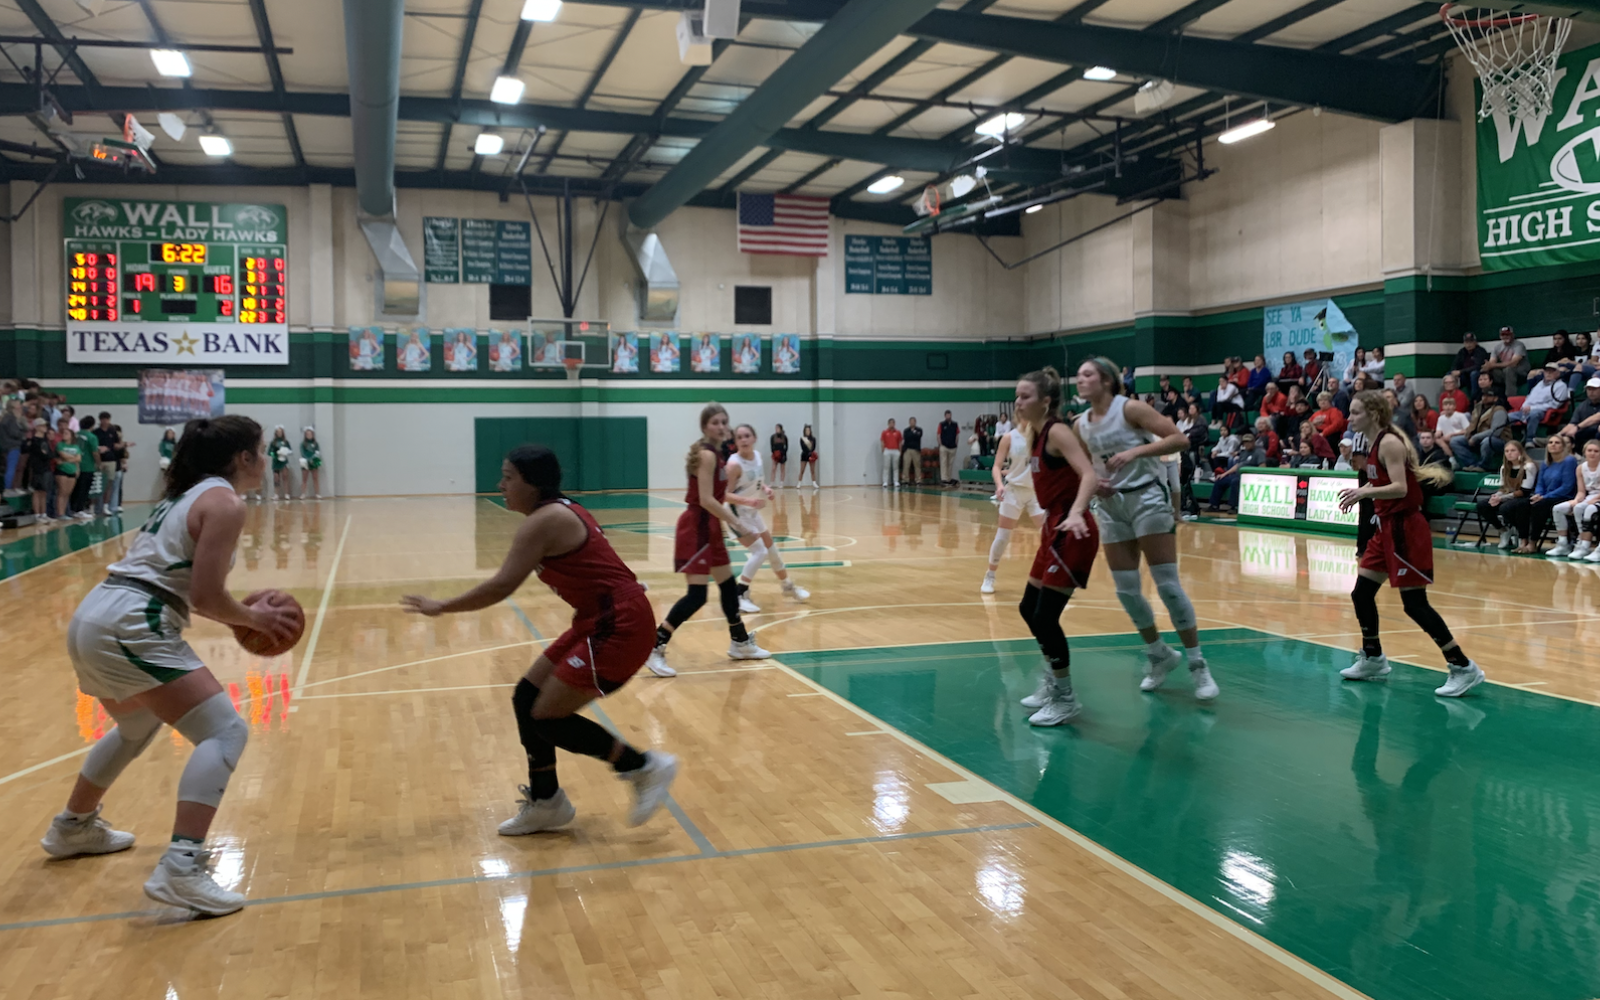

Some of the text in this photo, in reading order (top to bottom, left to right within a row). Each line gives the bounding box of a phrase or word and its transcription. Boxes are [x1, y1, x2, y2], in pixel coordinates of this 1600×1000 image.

[121, 202, 234, 229] WALL
[75, 225, 143, 238] HAWKS
[160, 226, 209, 240] LADY
[212, 229, 278, 243] HAWKS
[1484, 206, 1573, 248] HIGH
[86, 252, 98, 266] 0
[162, 243, 206, 264] 6:22
[202, 265, 231, 275] GUEST
[256, 257, 266, 270] 0
[274, 258, 284, 271] 0
[86, 267, 98, 280] 0
[106, 267, 116, 280] 0
[258, 270, 267, 284] 3
[106, 281, 116, 294] 3
[135, 272, 155, 292] 19
[173, 275, 186, 292] 3
[214, 274, 233, 294] 16
[106, 294, 117, 308] 2
[133, 298, 141, 314] 1
[221, 300, 234, 316] 2
[275, 298, 285, 310] 2
[68, 308, 87, 321] 40
[106, 308, 118, 322] 3
[258, 310, 268, 324] 3
[275, 310, 286, 324] 2
[1266, 306, 1302, 326] SEE YA
[72, 331, 282, 354] TEXAS BANK
[1265, 328, 1317, 349] L8R DUDE
[1242, 484, 1294, 505] WALL
[1242, 504, 1259, 514] HIGH
[1262, 504, 1290, 517] SCHOOL
[1308, 508, 1332, 520] LADY
